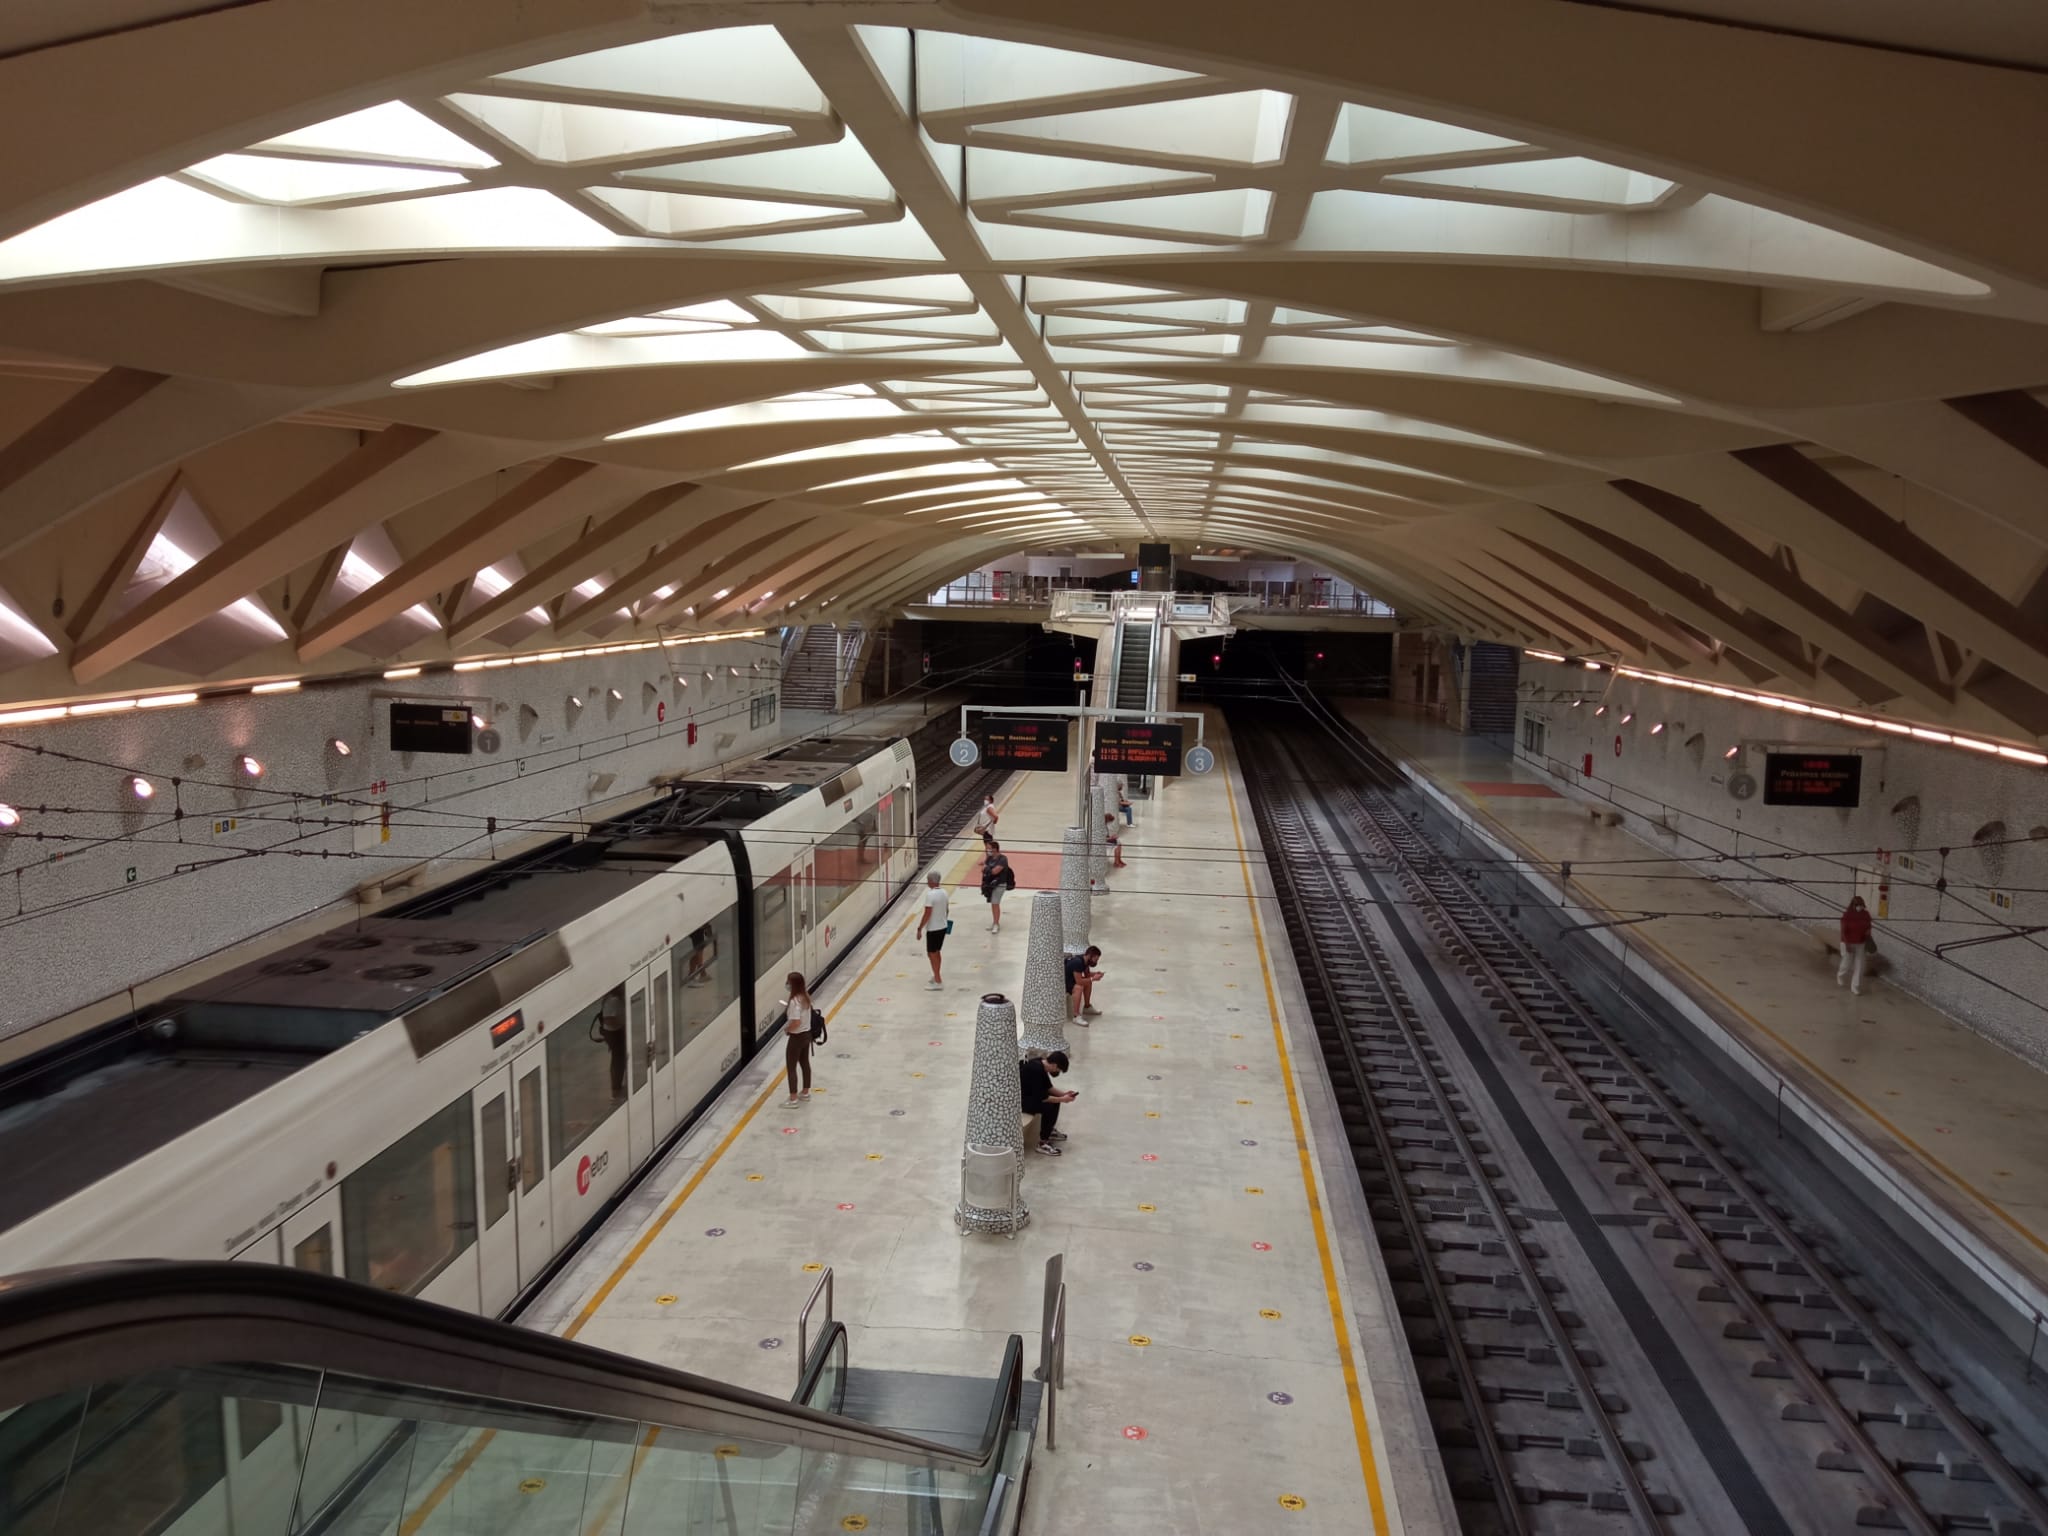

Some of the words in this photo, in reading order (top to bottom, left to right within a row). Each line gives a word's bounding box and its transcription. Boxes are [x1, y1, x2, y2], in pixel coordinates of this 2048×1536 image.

[959, 749, 969, 762] 2
[1195, 758, 1205, 771] 3
[1737, 784, 1747, 797] 4
